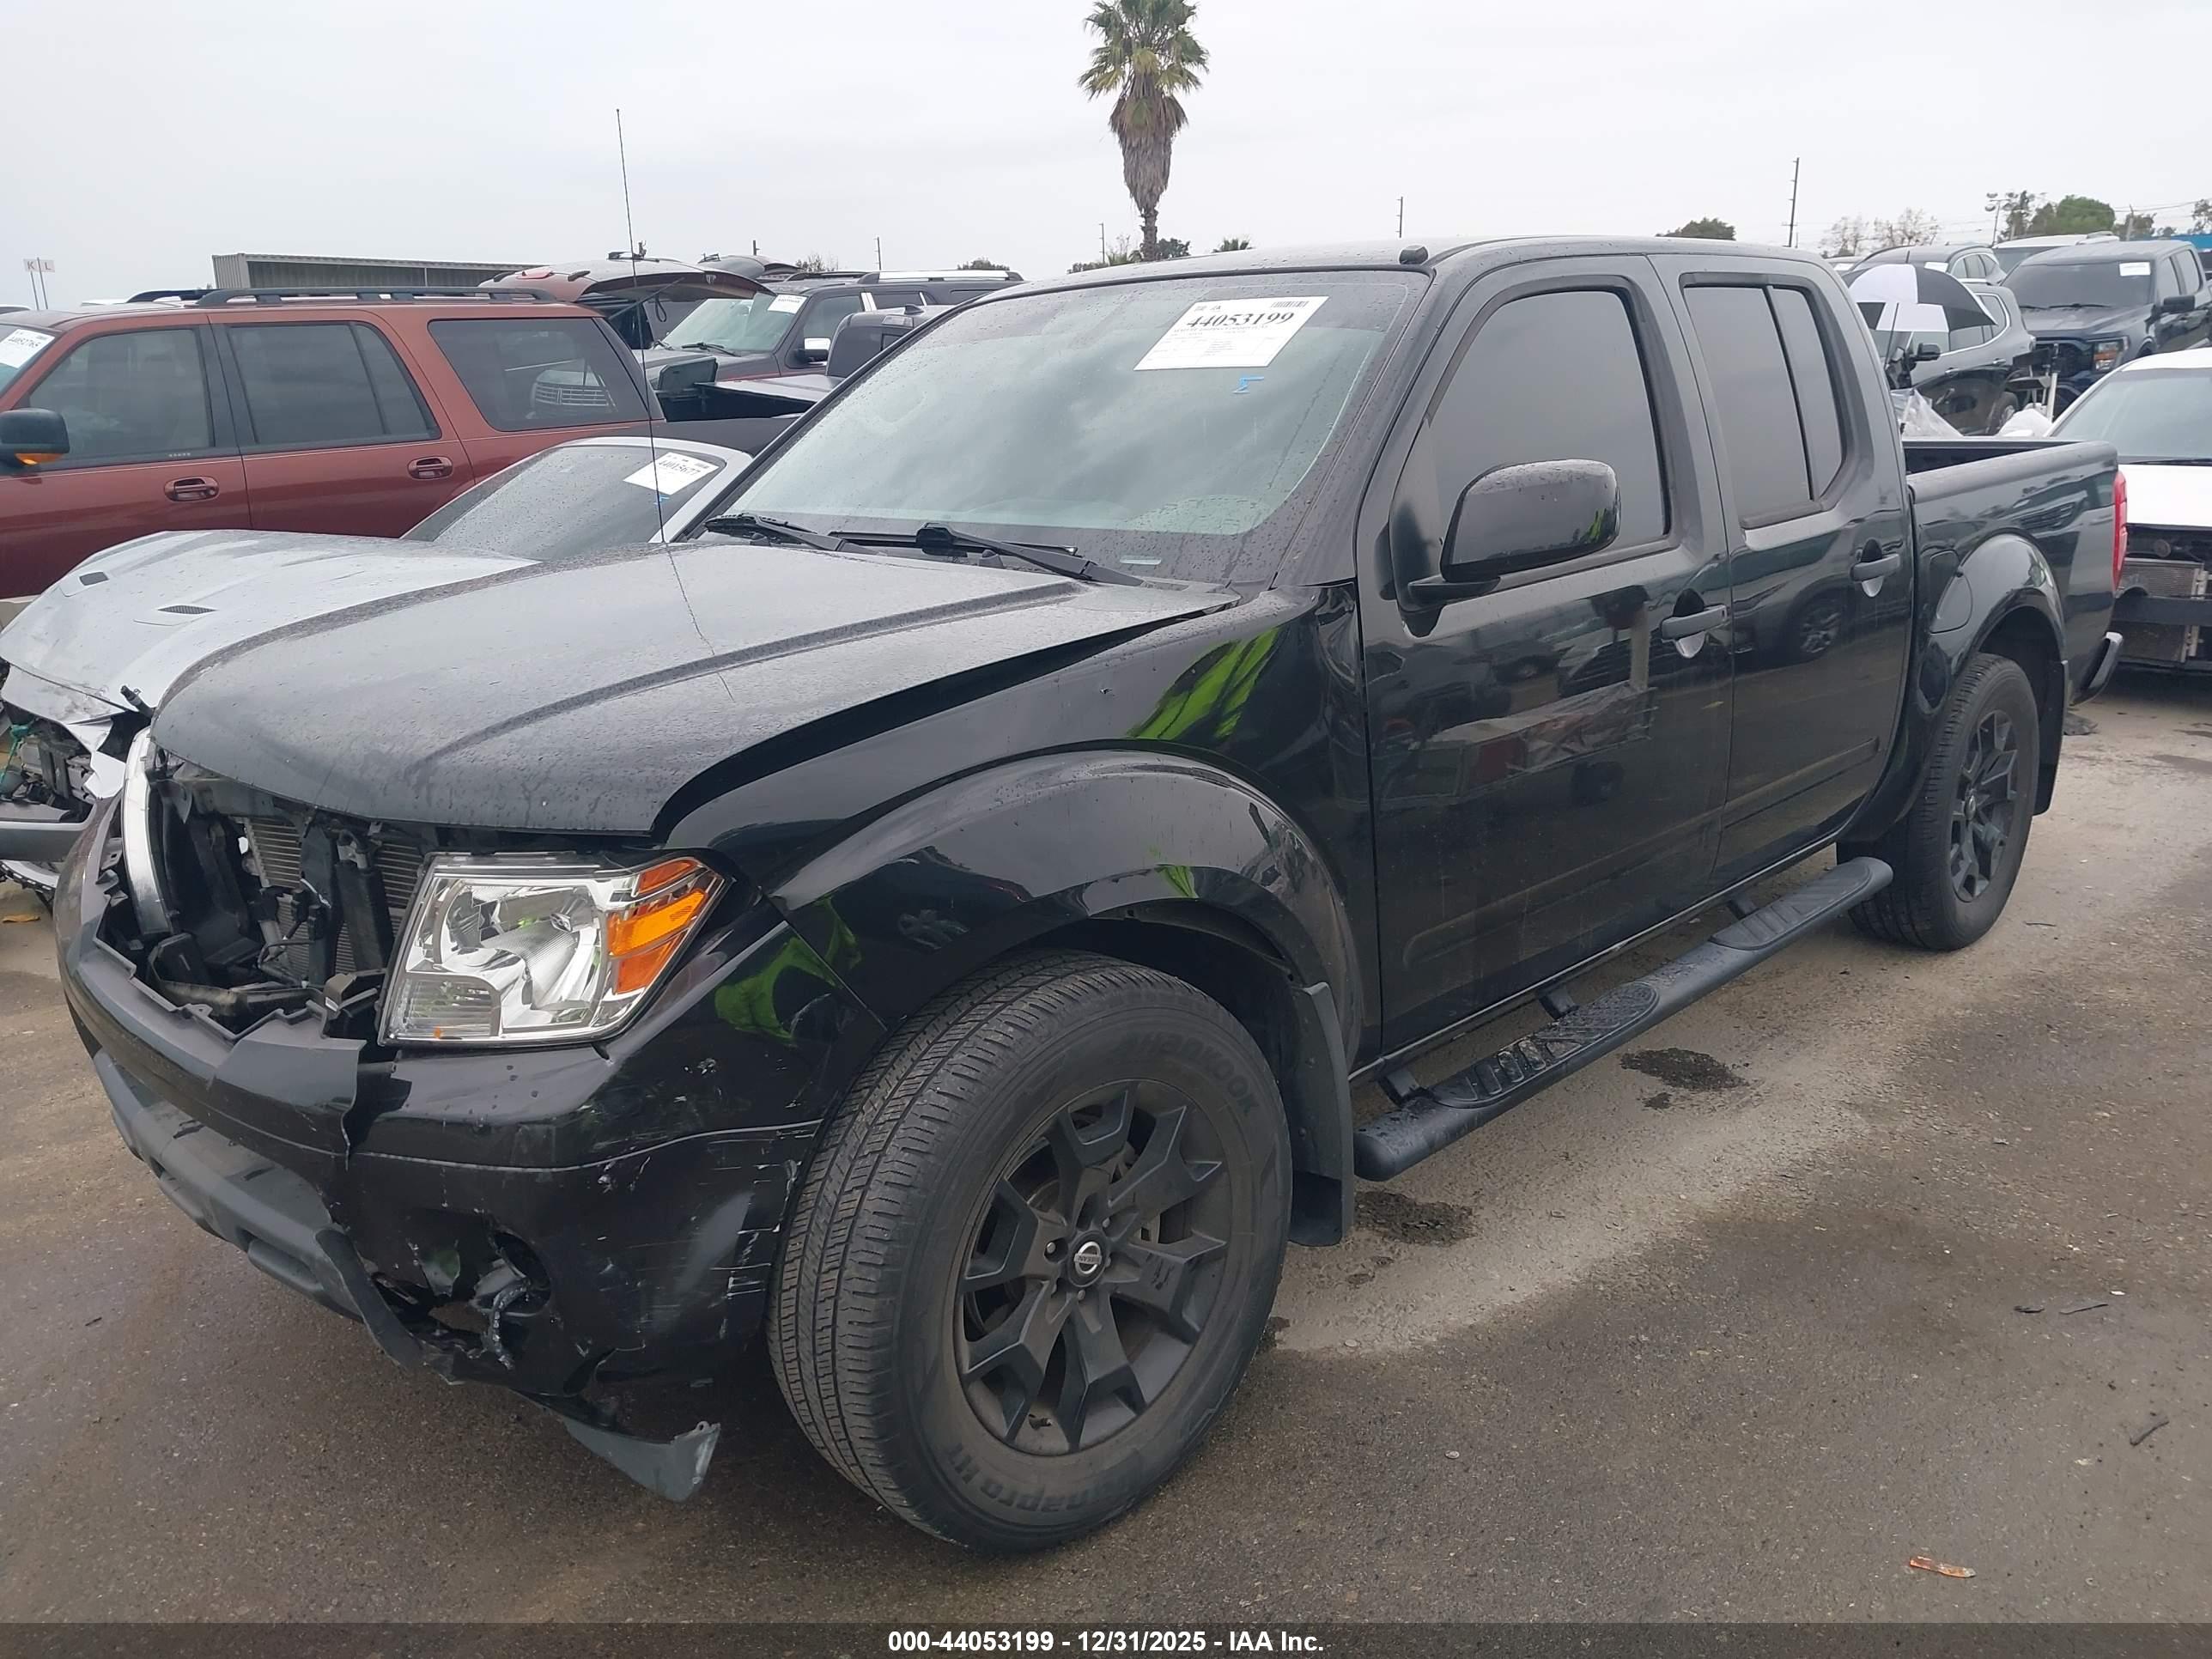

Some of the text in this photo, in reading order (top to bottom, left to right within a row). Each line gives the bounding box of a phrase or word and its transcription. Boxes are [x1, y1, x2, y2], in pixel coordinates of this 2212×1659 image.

[27, 260, 35, 270] K
[44, 261, 52, 270] L
[1187, 312, 1295, 327] 44053199
